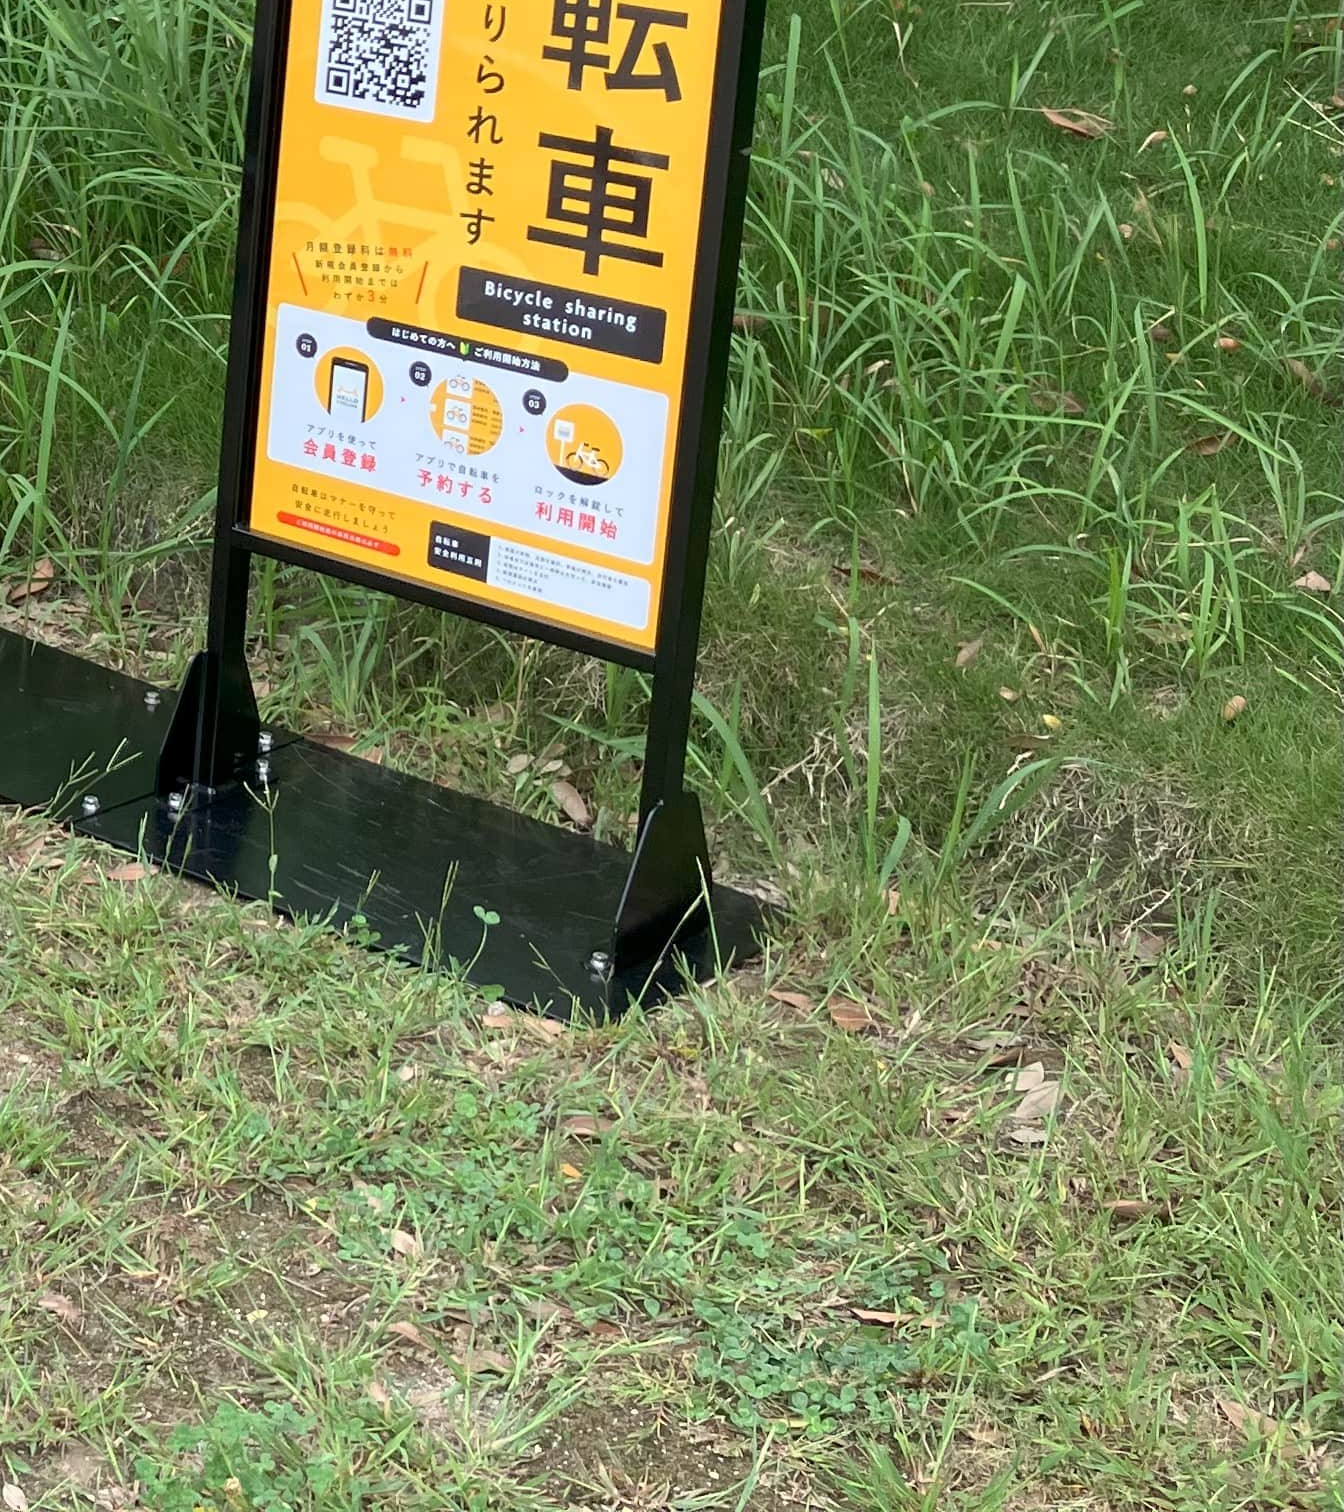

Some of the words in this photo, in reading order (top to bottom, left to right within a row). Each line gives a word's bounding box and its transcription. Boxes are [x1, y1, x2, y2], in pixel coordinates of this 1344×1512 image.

[484, 280, 554, 310] Bicycle
[564, 299, 638, 334] sharing
[391, 327, 457, 351] はじめての方へ
[523, 313, 593, 341] station
[300, 343, 312, 353] 01
[414, 371, 426, 381] 02
[528, 399, 540, 409] 03
[306, 423, 377, 450] アプリを使って
[303, 438, 377, 473] 会員登録
[415, 452, 501, 484] アプリで自転車を
[417, 468, 493, 505] 予約する
[534, 501, 619, 540] 利用開始
